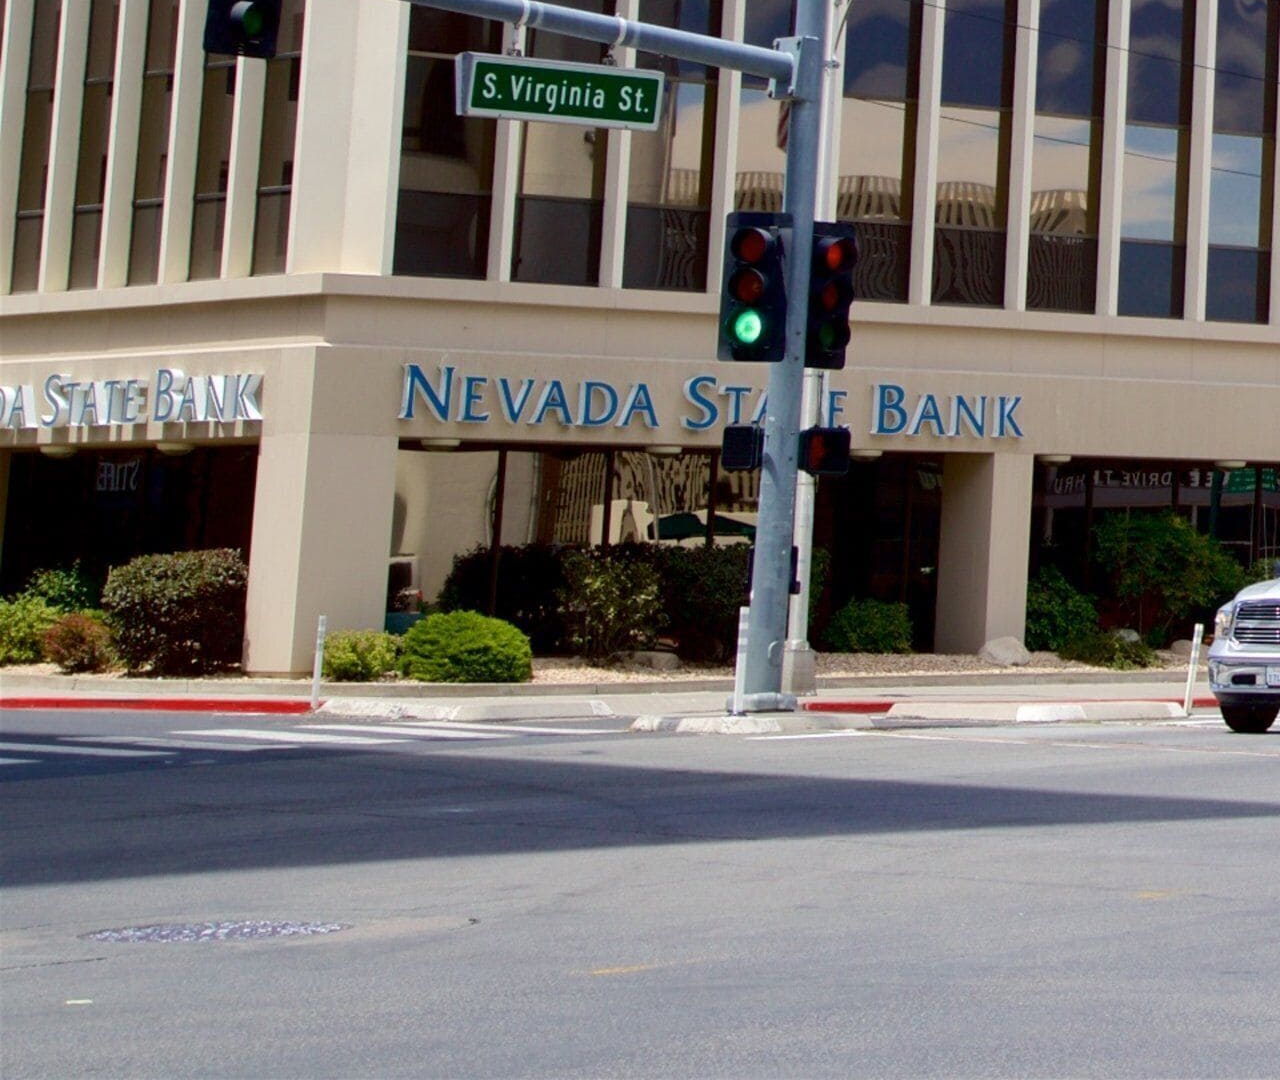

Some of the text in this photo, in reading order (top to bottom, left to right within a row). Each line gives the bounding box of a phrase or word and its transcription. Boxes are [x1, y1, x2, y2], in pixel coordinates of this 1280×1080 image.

[482, 72, 650, 114] S. Virginia St.
[41, 373, 150, 429] STATE
[154, 368, 263, 424] BANK
[398, 363, 660, 429] NEVADA
[869, 383, 1024, 439] BANK
